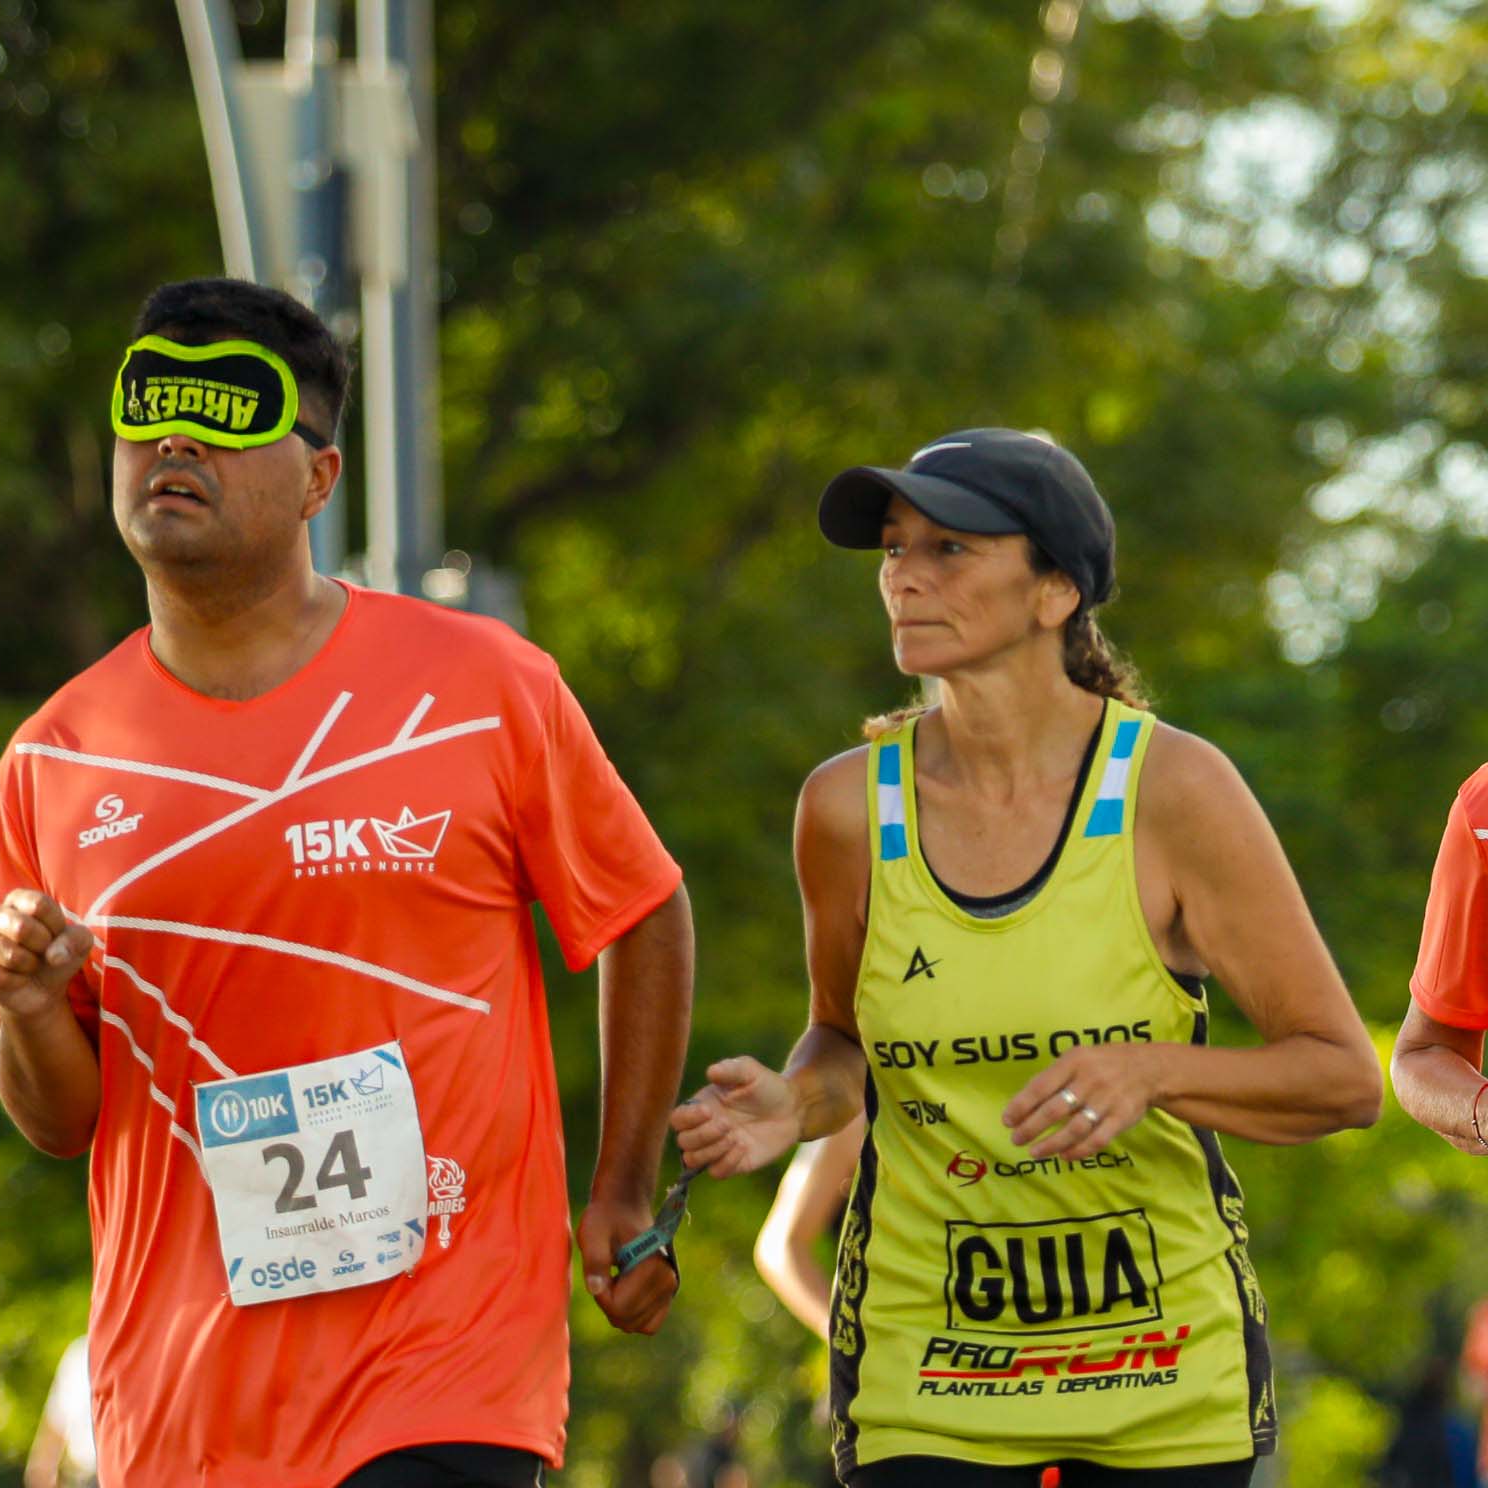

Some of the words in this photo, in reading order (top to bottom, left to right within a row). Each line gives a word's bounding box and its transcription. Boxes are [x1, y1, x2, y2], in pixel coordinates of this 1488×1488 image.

[284, 818, 370, 864] 15K
[294, 861, 370, 879] PUERTO
[378, 861, 436, 873] NORTE
[874, 1039, 939, 1069] SOY
[952, 1033, 1039, 1065] SUS
[248, 1093, 289, 1120] 10K
[303, 1080, 350, 1108] 15K
[262, 1129, 373, 1214] 24
[265, 1217, 336, 1241] Insaurralde
[339, 1205, 391, 1227] Marcos
[251, 1256, 317, 1289] osde
[955, 1227, 1150, 1324] GUIA
[918, 1379, 1044, 1396] PLANTILLAS
[1057, 1369, 1178, 1394] DEPORTIVAS
